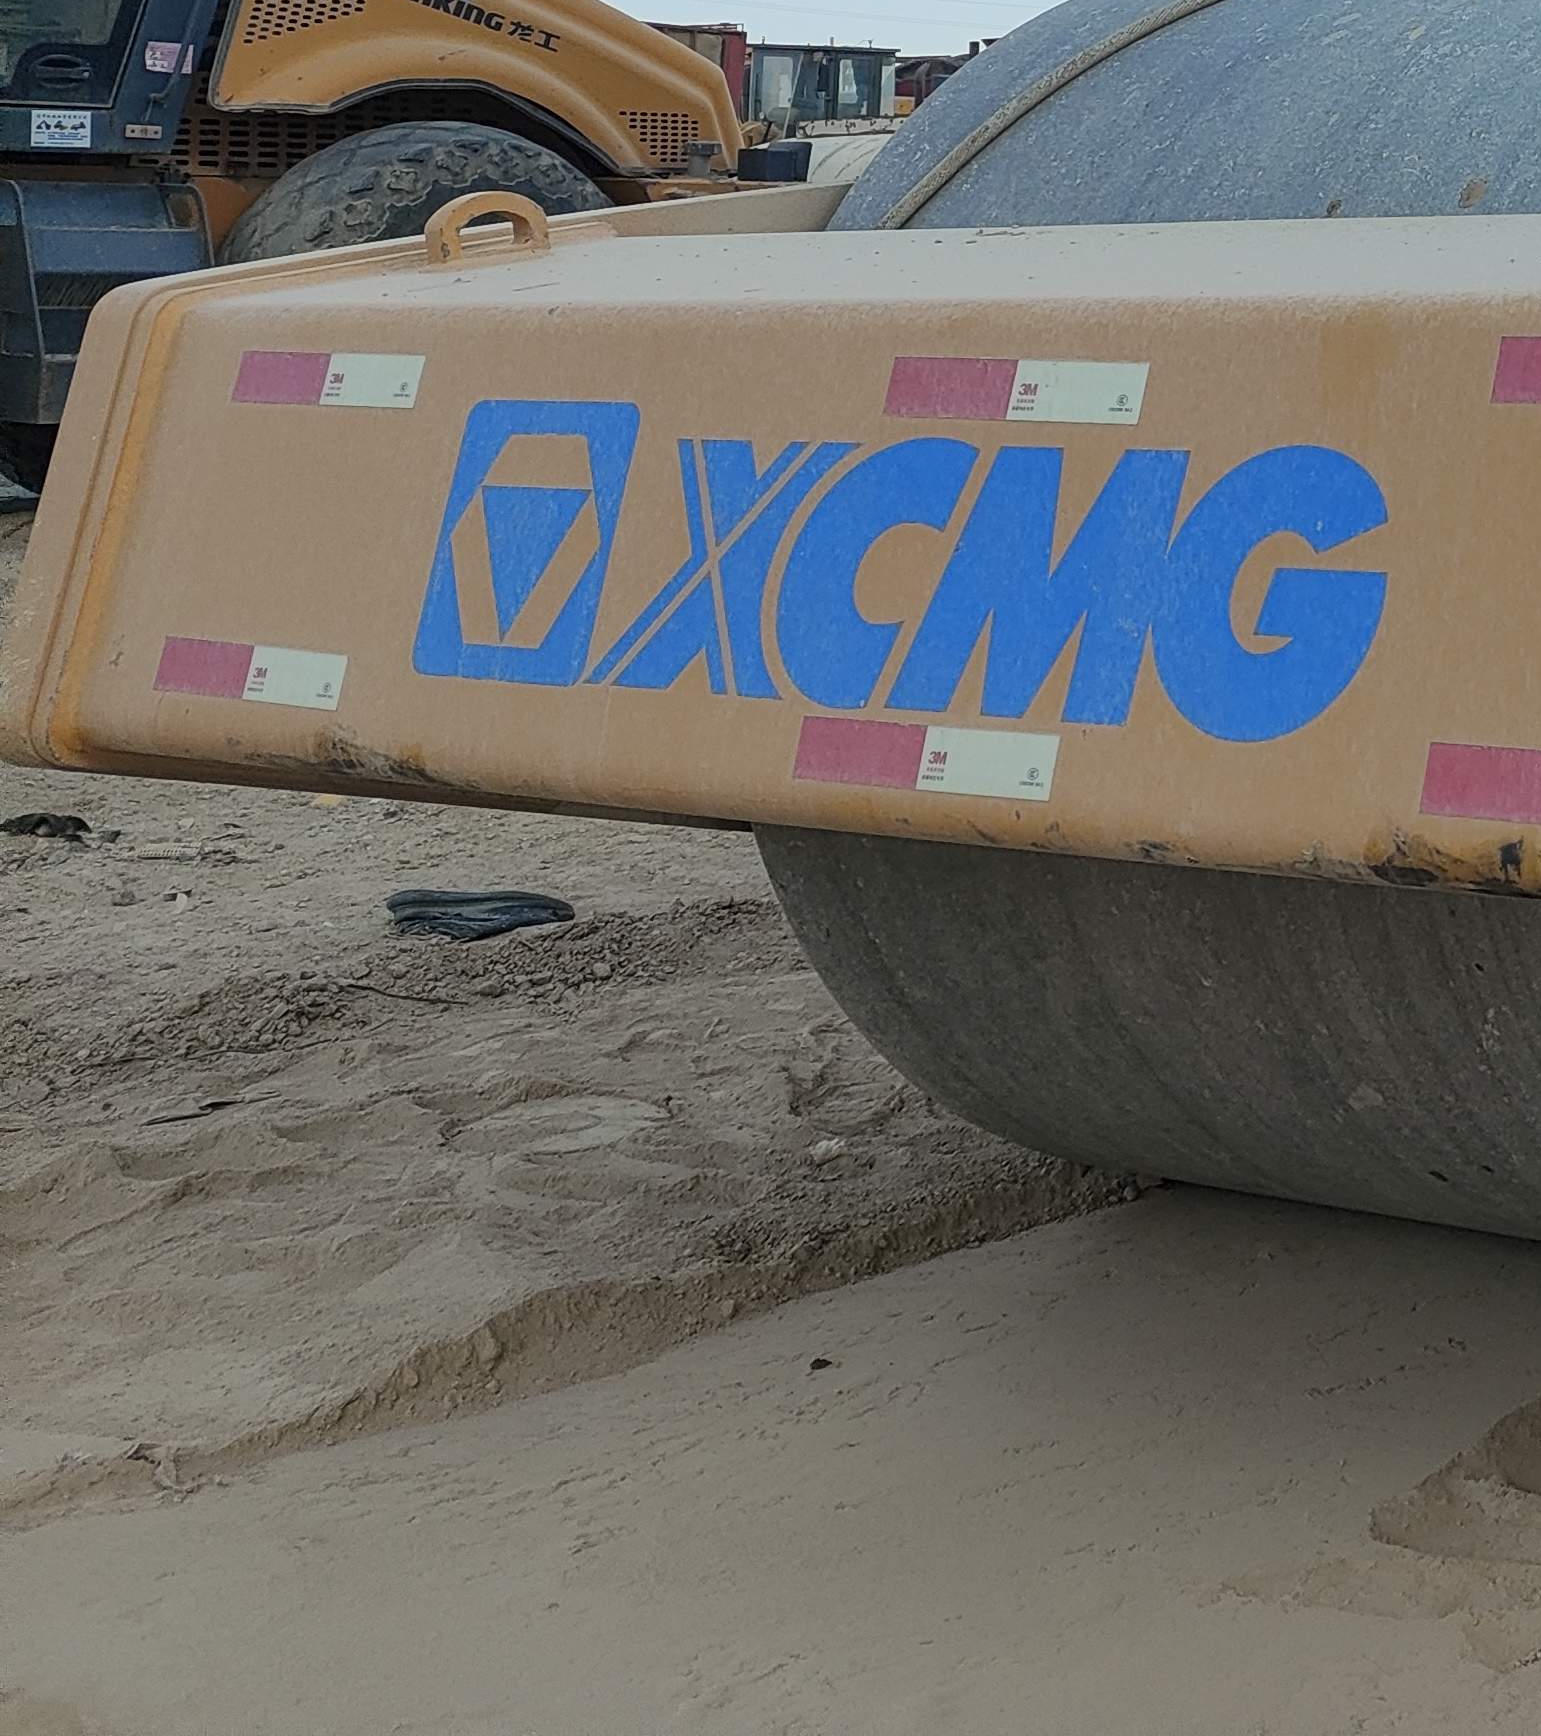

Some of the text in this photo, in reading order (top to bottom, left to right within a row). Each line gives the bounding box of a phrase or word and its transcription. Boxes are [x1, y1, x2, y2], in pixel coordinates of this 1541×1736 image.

[1018, 383, 1039, 396] 3M
[583, 436, 1389, 743] XCMG
[928, 751, 948, 766] 3M
